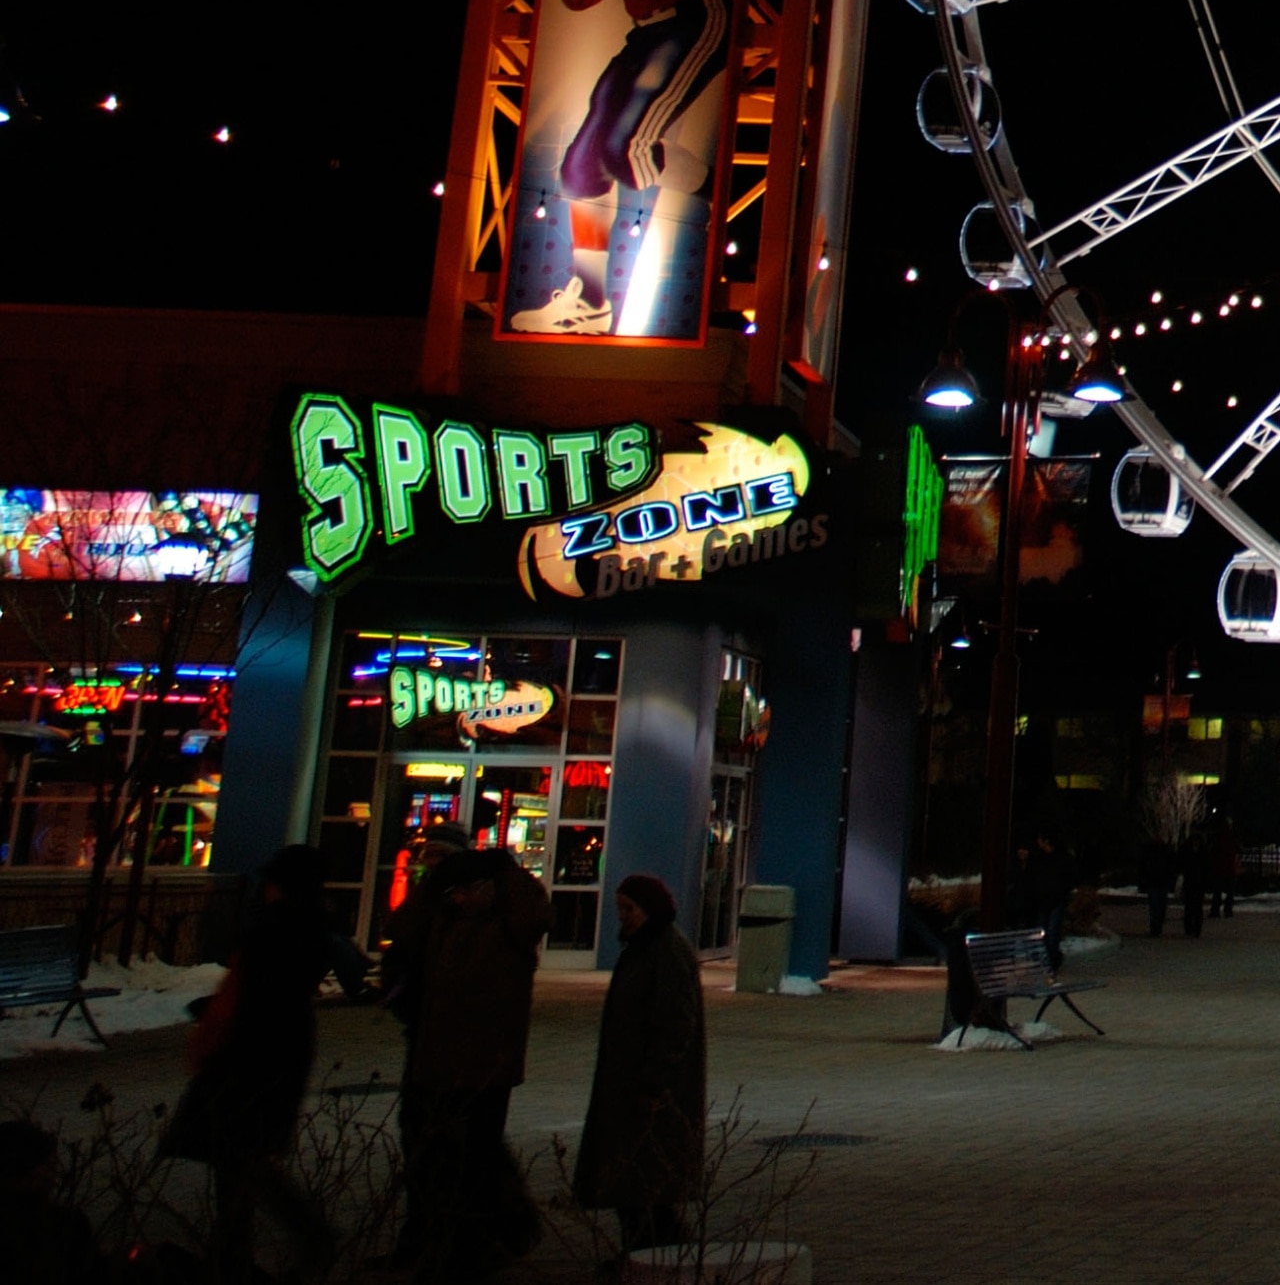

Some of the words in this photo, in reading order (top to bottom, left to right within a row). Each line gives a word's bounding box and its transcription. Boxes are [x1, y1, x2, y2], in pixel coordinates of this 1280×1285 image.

[290, 391, 652, 584] SPORTS
[561, 471, 800, 559] ZONE
[593, 551, 668, 601] Bar
[701, 513, 831, 579] Games
[390, 665, 507, 729] SPORTS
[465, 700, 544, 723] ZONE
